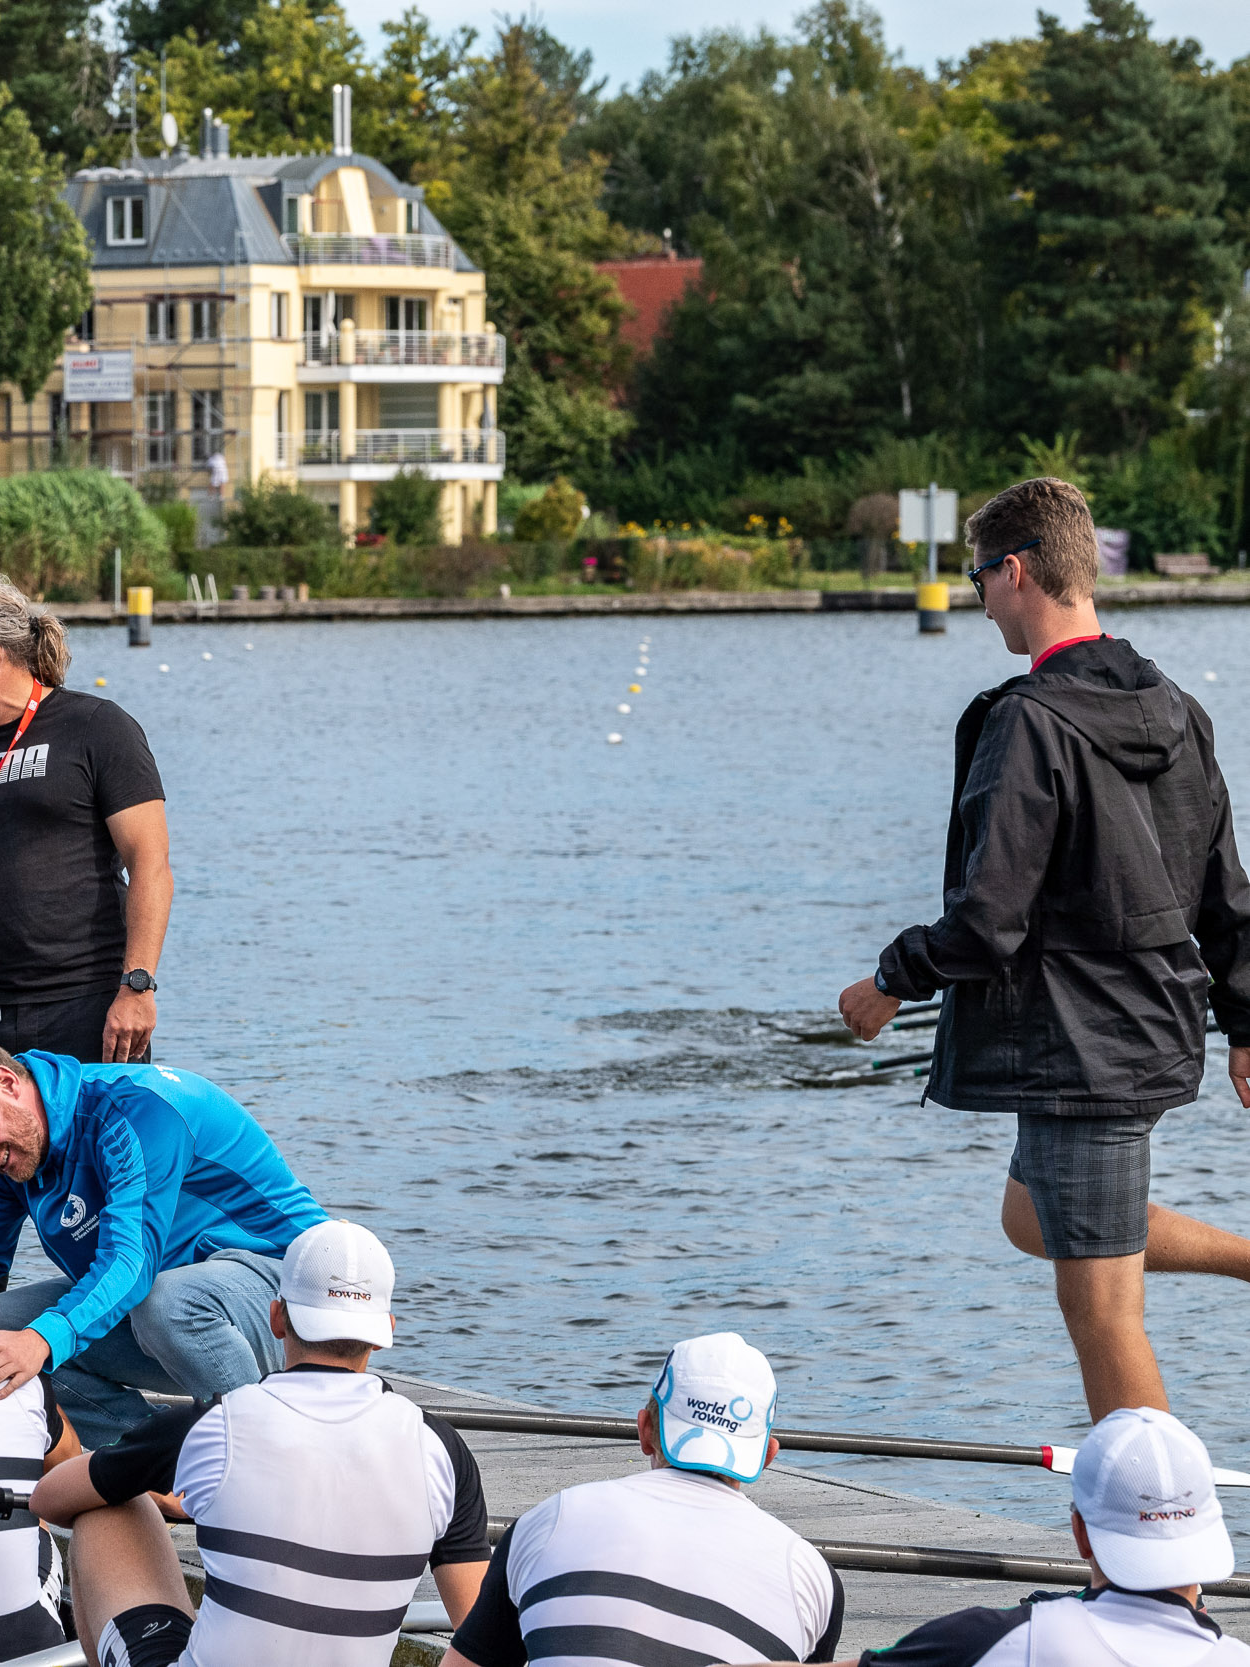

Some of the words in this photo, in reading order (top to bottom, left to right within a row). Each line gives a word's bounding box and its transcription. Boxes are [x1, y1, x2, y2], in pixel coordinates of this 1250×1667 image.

[327, 1289, 372, 1301] ROWING
[687, 1397, 727, 1416] world
[691, 1410, 739, 1433] rowing
[1138, 1507, 1196, 1521] ROWING
